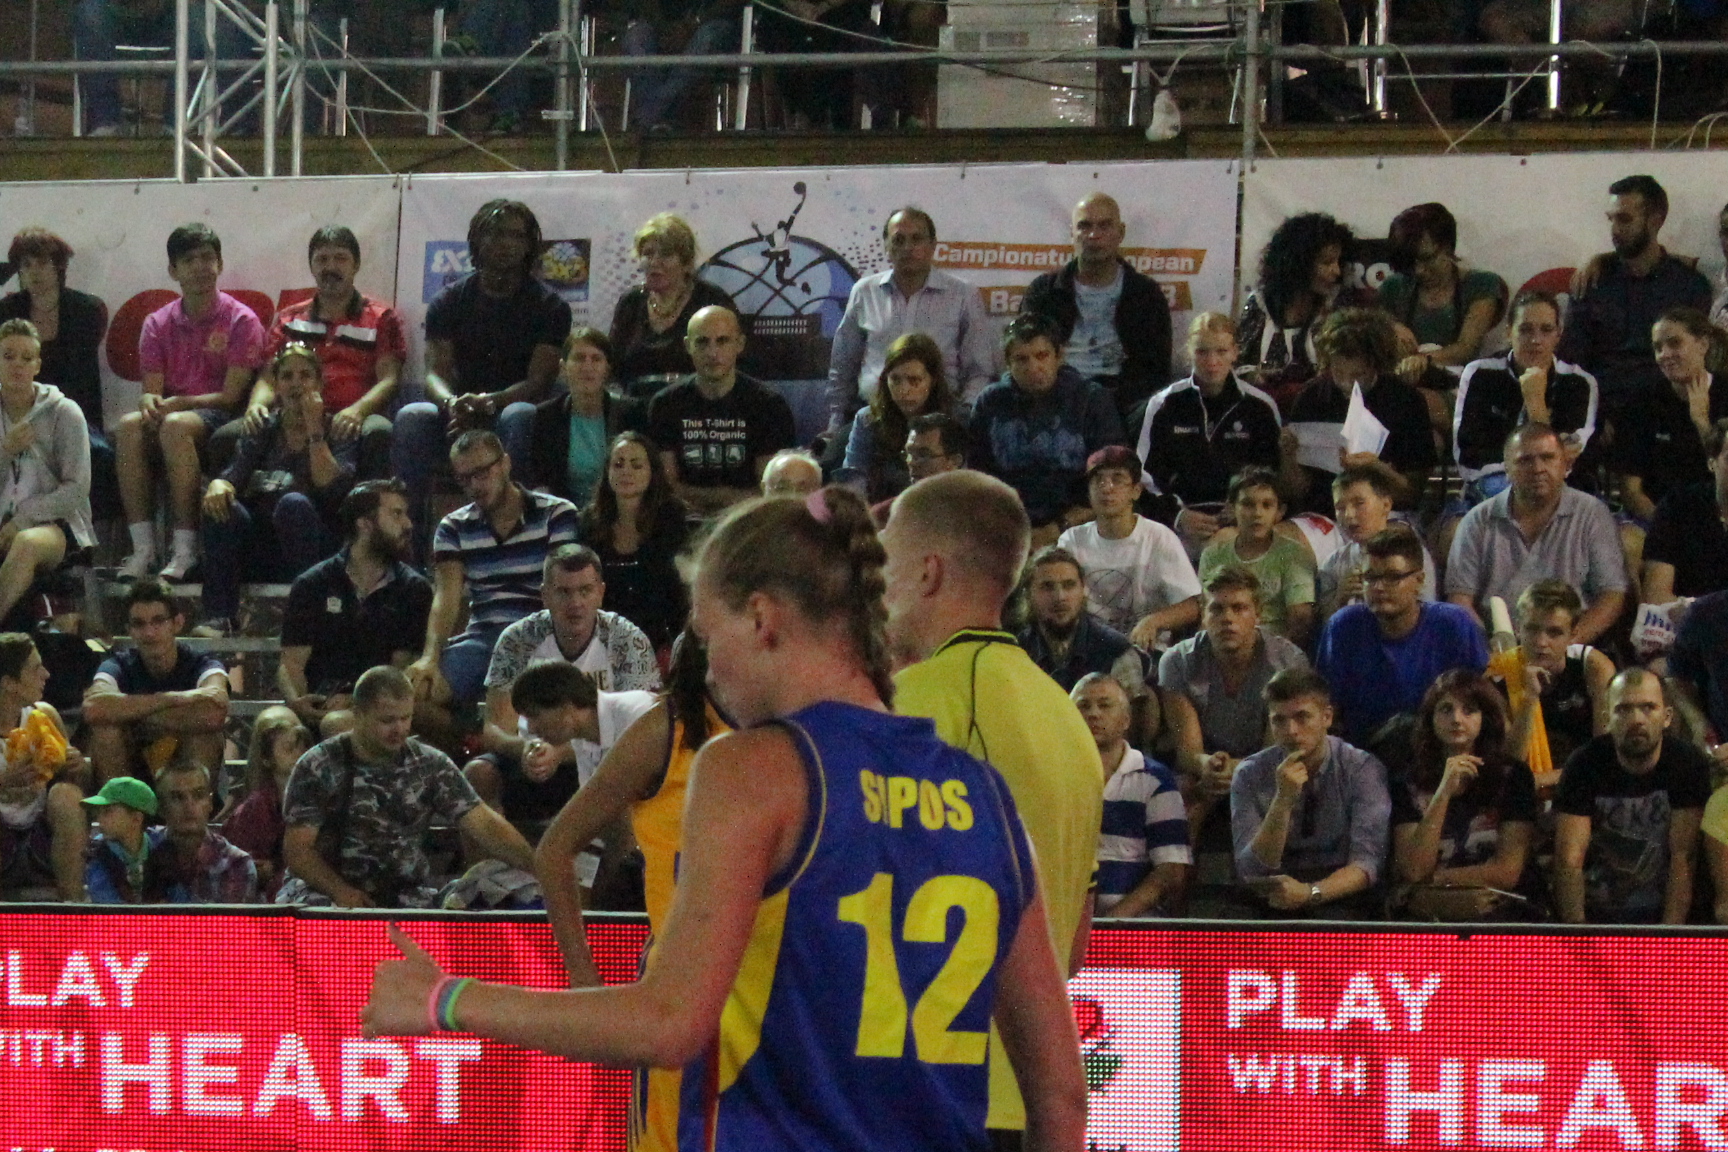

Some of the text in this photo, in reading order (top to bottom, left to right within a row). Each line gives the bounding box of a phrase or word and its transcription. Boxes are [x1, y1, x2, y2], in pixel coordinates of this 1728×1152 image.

[932, 243, 1073, 267] Campionatu
[682, 418, 703, 428] This
[682, 430, 746, 441] 100% Organic
[859, 768, 974, 832] SIPOS
[836, 871, 1001, 1066] 12
[1227, 968, 1442, 1032] PLAY
[99, 1031, 483, 1125] HEART
[1227, 1053, 1728, 1152] WITH HEAR
